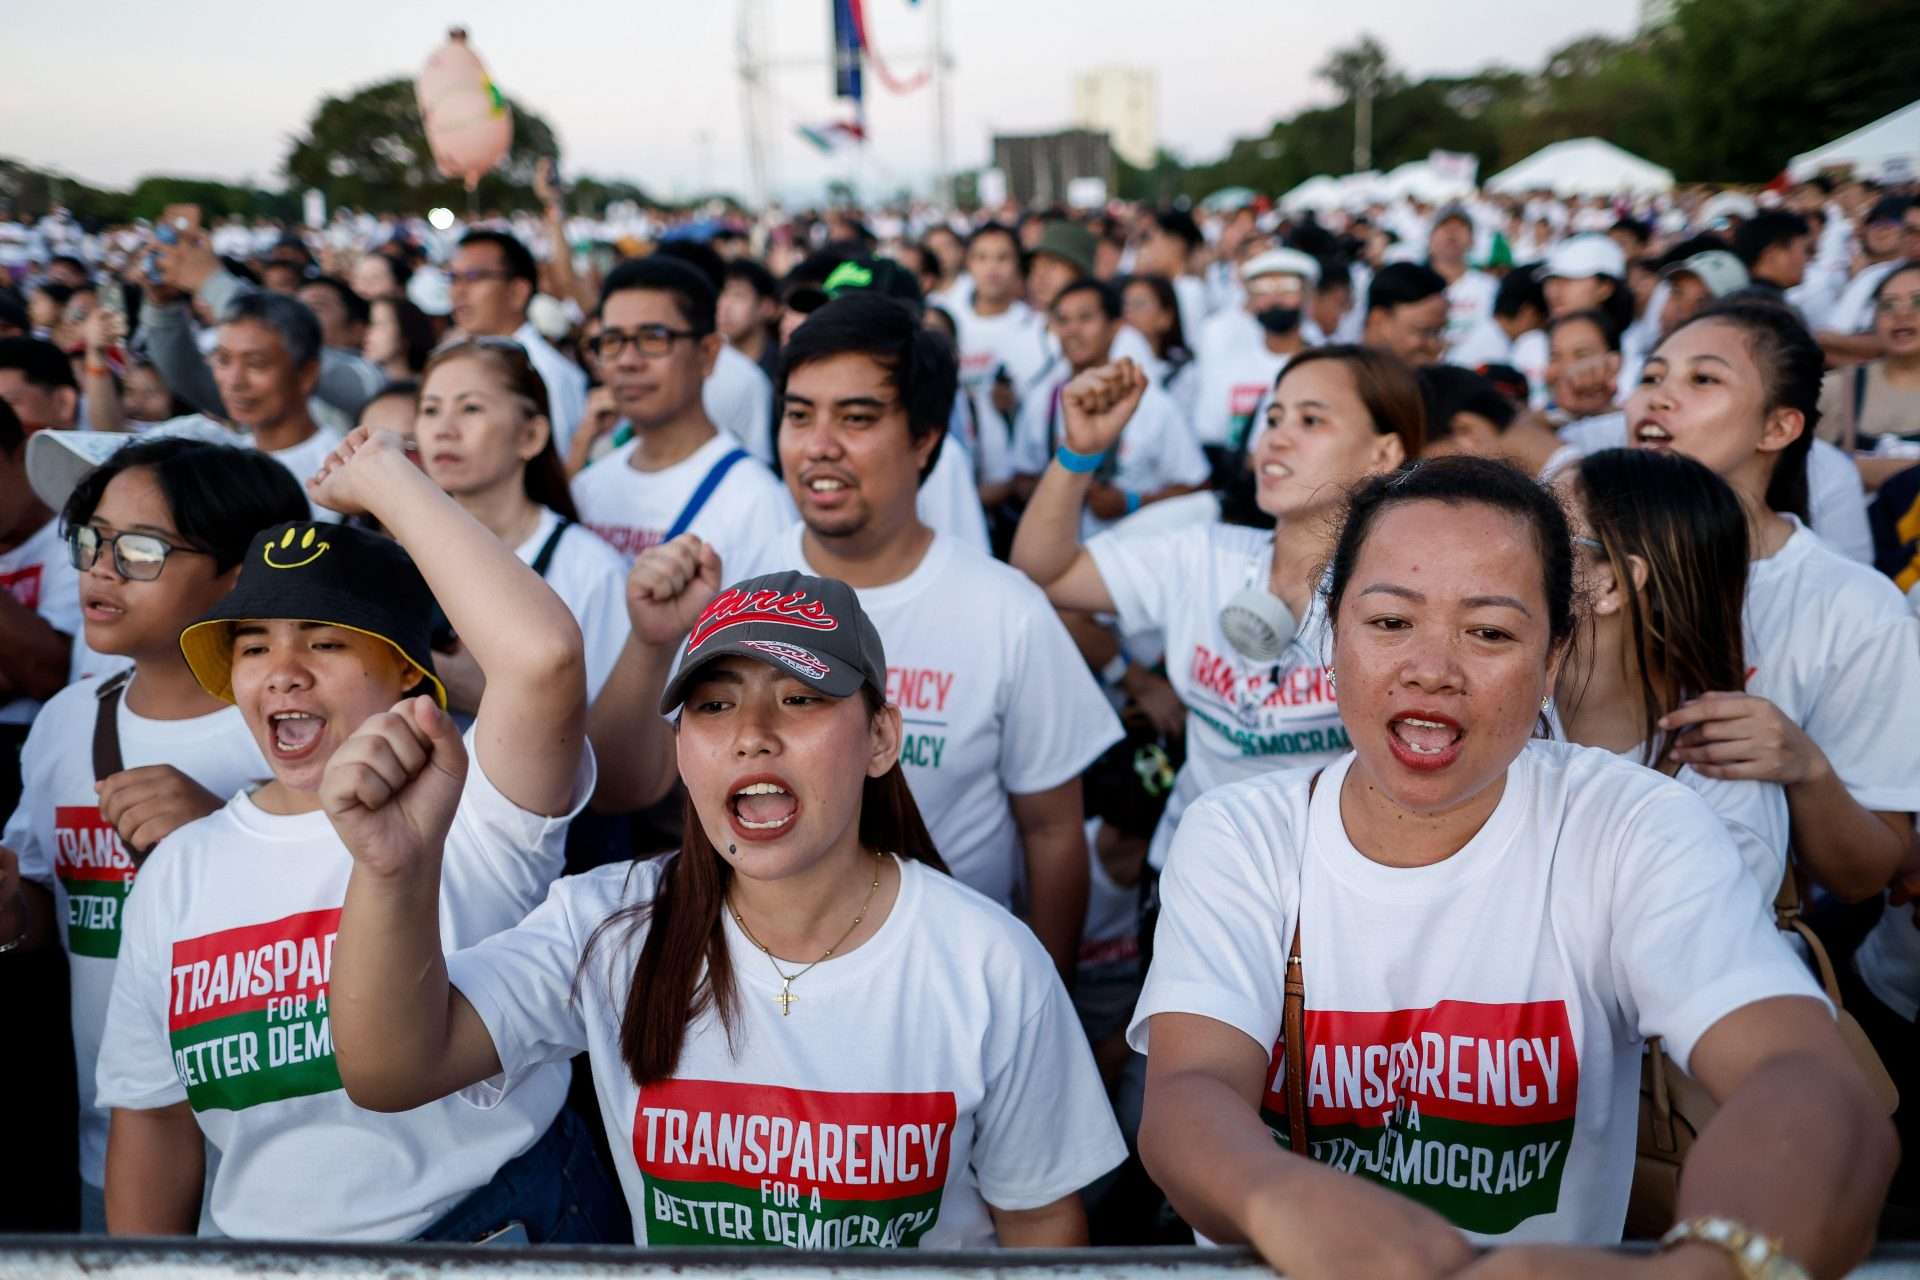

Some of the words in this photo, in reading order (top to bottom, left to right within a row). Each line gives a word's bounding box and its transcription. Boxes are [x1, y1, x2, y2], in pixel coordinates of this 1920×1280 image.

[901, 734, 946, 768] ACY
[55, 827, 136, 870] TRANS
[266, 993, 308, 1023] FOR
[316, 989, 327, 1015] A
[174, 1031, 261, 1088] BETTER
[268, 1016, 336, 1068] DEM
[1271, 1031, 1561, 1108] ANSPARENCY
[1406, 1099, 1421, 1131] A
[642, 1107, 947, 1185] TRANSPARENCY
[652, 1186, 756, 1241] BETTER
[762, 1207, 934, 1250] DEMOCRACY
[760, 1179, 800, 1209] FOR
[809, 1186, 821, 1214] A
